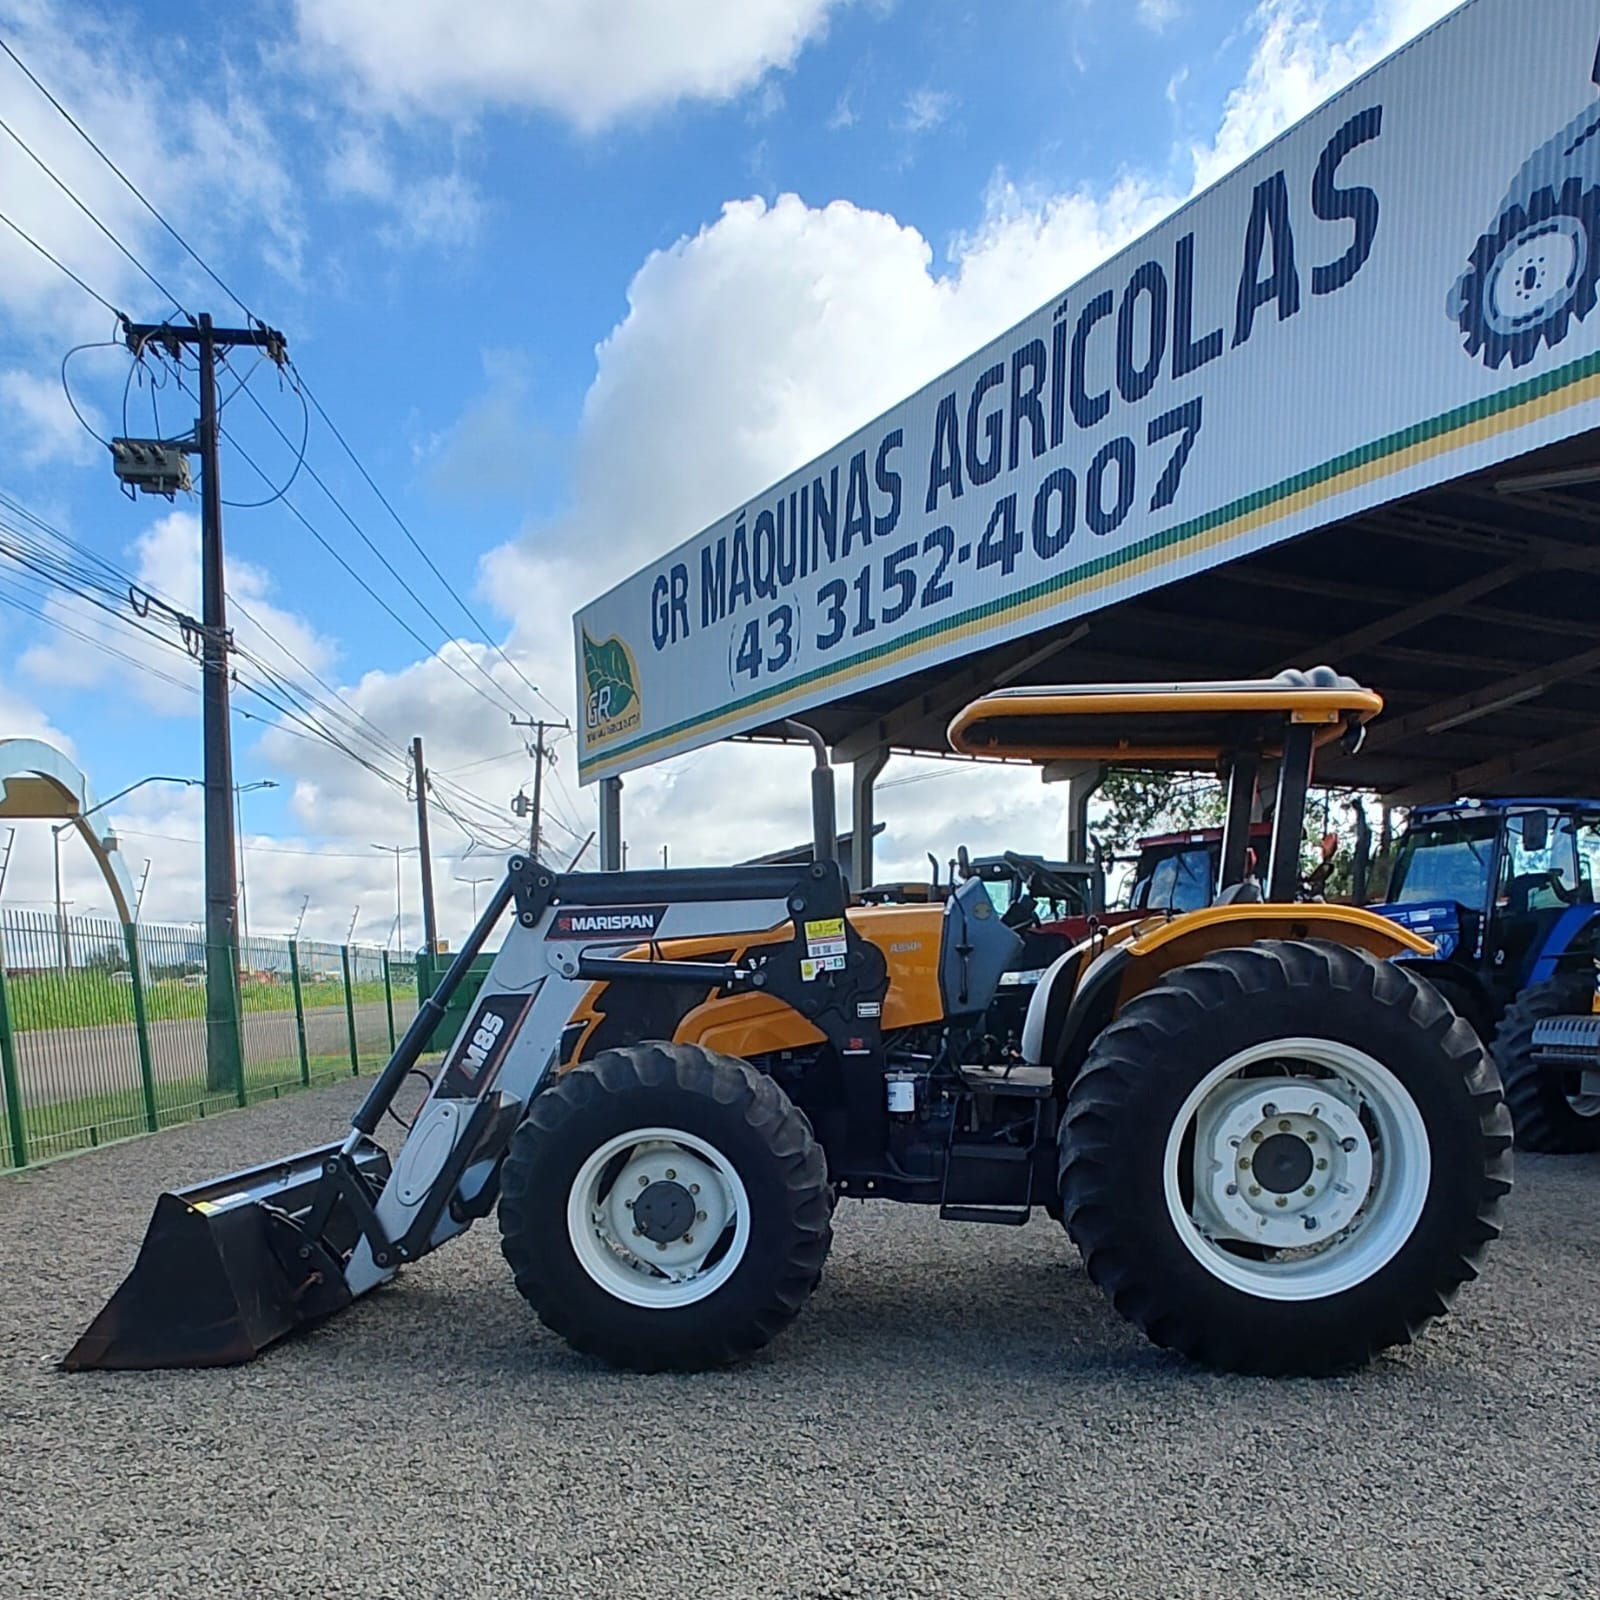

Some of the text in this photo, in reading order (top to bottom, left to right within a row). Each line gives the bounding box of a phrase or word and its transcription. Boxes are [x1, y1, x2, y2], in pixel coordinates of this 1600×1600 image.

[651, 104, 1383, 651] GR MÁQUINAS AGRÍCOLAS
[728, 395, 1202, 692] (43) 3152-4007
[586, 685, 612, 729] GR
[571, 914, 654, 931] MARISPAN
[460, 1012, 504, 1079] M85
